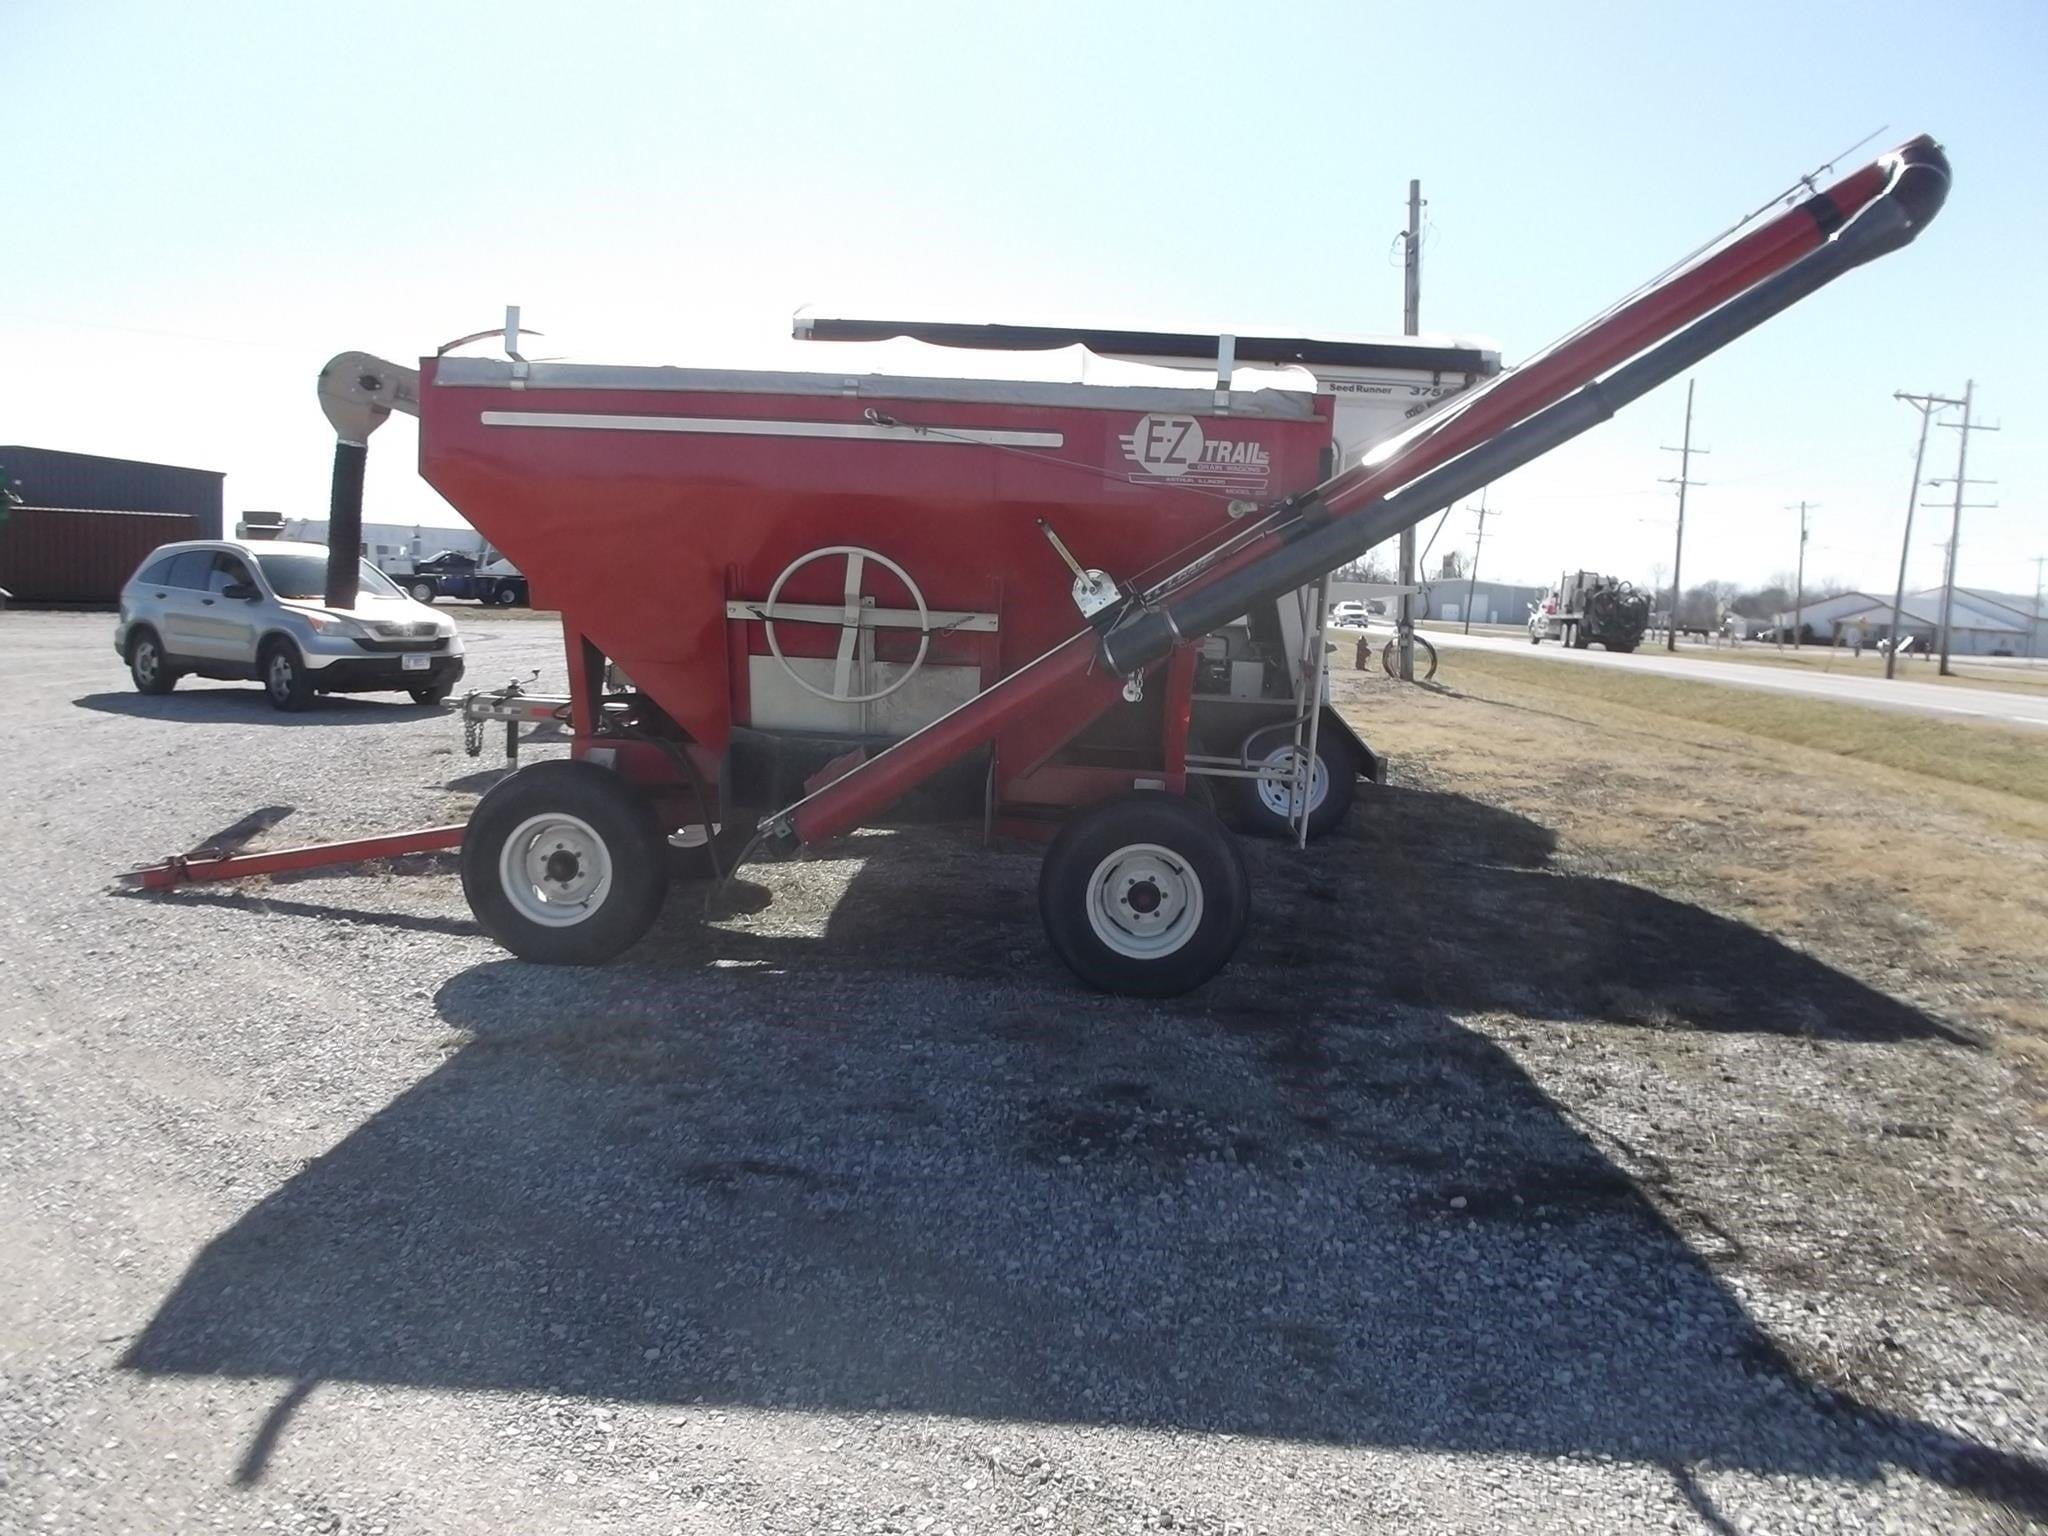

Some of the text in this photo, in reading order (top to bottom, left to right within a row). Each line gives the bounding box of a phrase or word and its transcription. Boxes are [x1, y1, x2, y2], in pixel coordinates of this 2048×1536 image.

[1329, 384, 1355, 393] Seed
[1356, 385, 1393, 395] Runner
[1205, 440, 1270, 465] TRAIL
